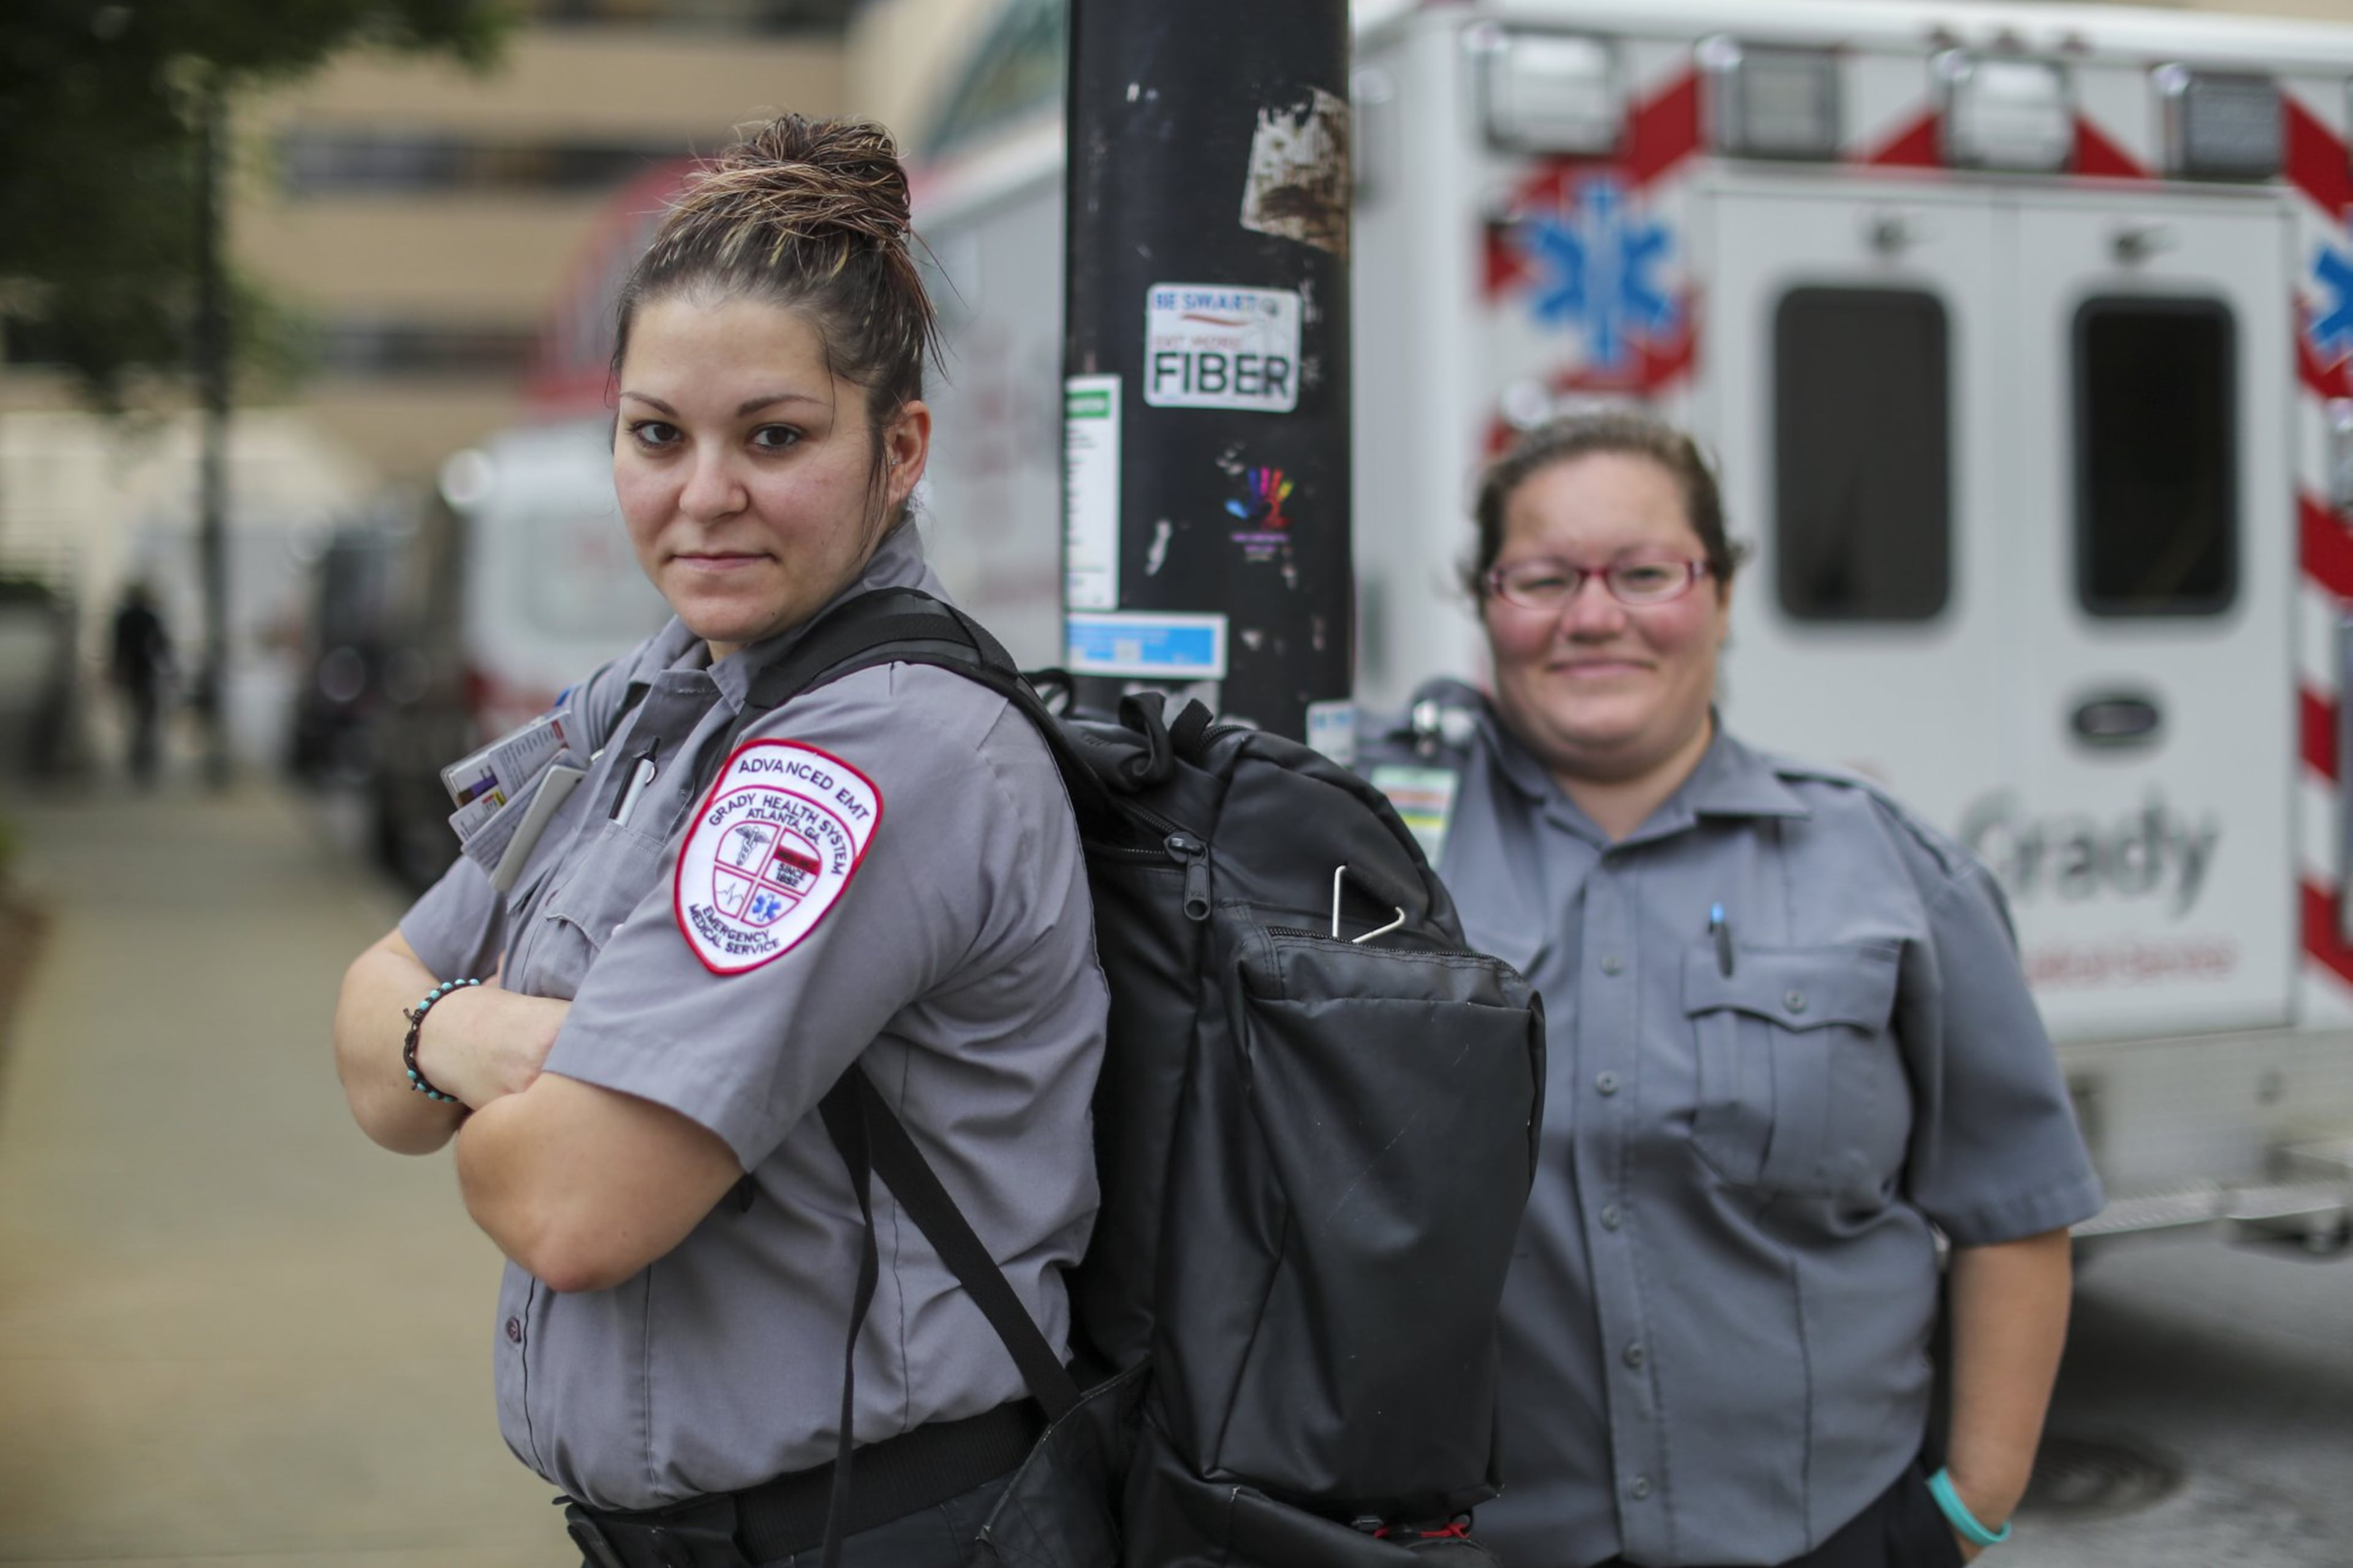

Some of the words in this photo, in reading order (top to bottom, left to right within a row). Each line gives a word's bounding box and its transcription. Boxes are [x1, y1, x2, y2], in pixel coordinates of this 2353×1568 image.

[1154, 352, 1290, 398] FIBER
[738, 758, 835, 790] ADVANCED
[836, 787, 870, 820] EMT
[708, 793, 756, 826] GRADY
[762, 794, 820, 825] HEALTH
[819, 819, 847, 876] SYSTEM
[804, 826, 820, 845] GA
[689, 903, 722, 948] MEDICAL
[725, 938, 780, 955] SERVICE
[703, 905, 770, 942] EMERGENCY
